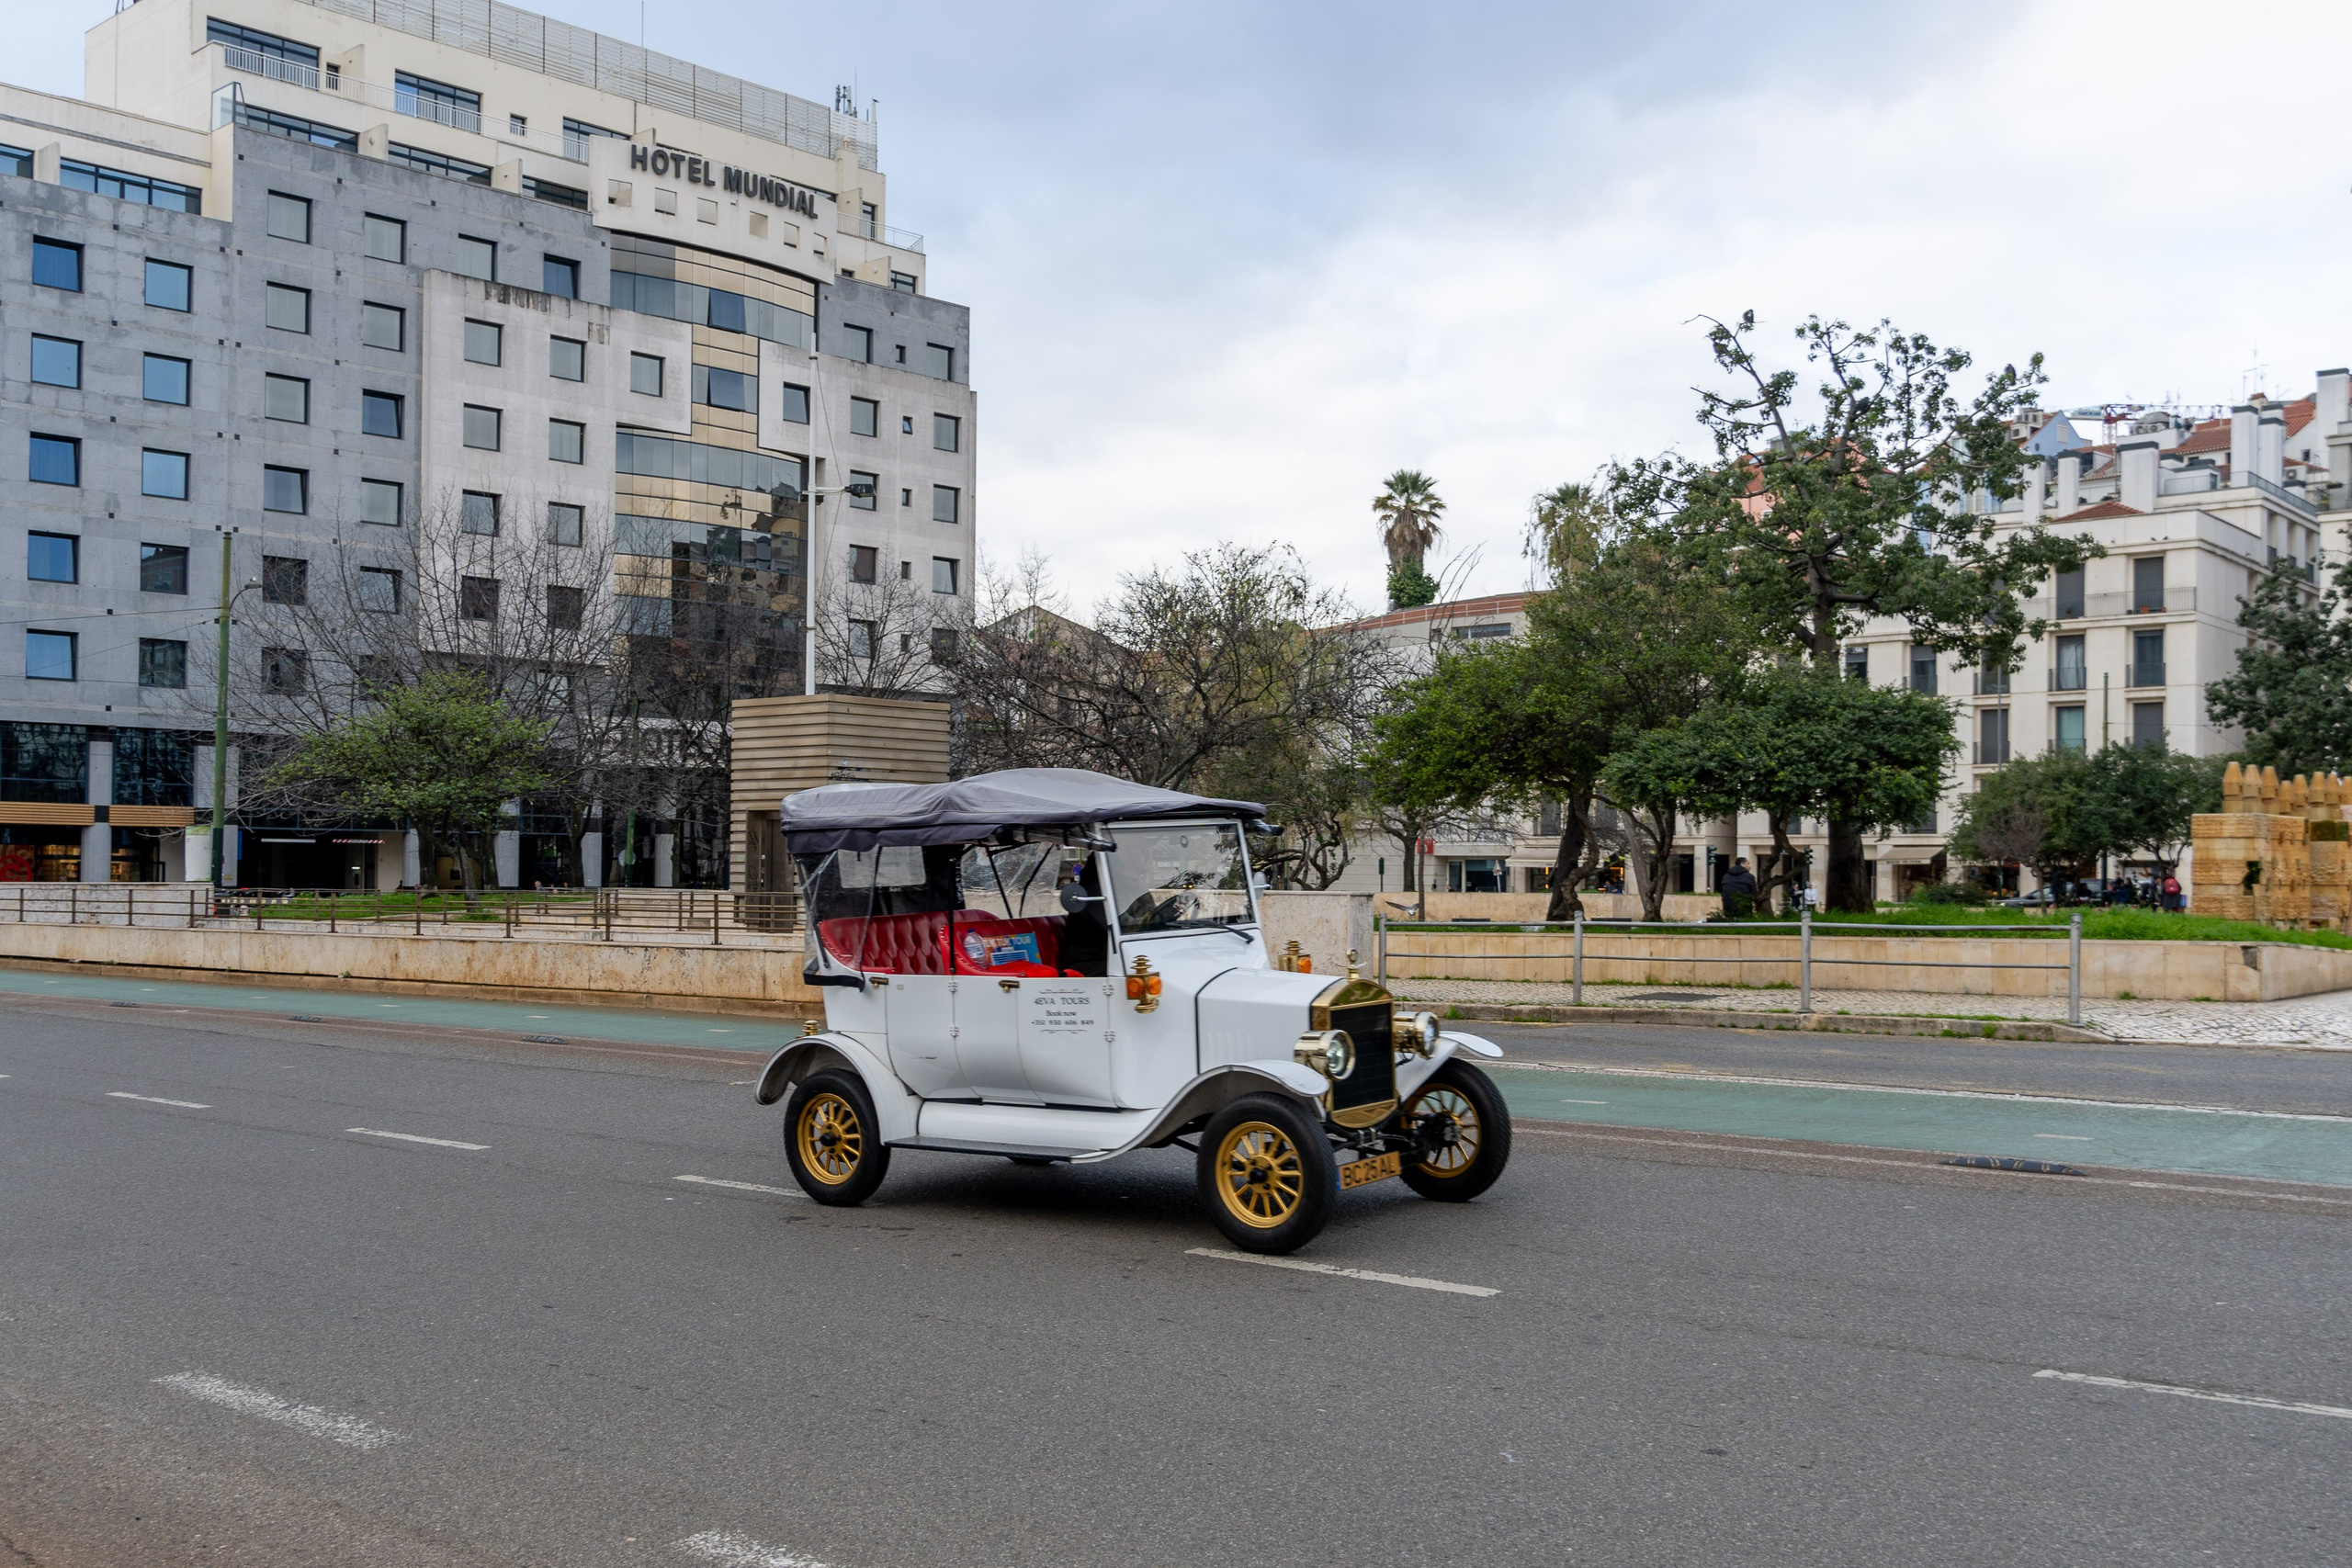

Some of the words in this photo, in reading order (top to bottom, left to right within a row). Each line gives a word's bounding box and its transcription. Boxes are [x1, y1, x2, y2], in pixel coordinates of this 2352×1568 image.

[631, 144, 716, 186] HOTEL
[723, 166, 819, 220] MUNDIAL
[1011, 935, 1032, 945] TOUR
[1034, 997, 1056, 1005] 4EVA
[1060, 997, 1091, 1005] TOURS
